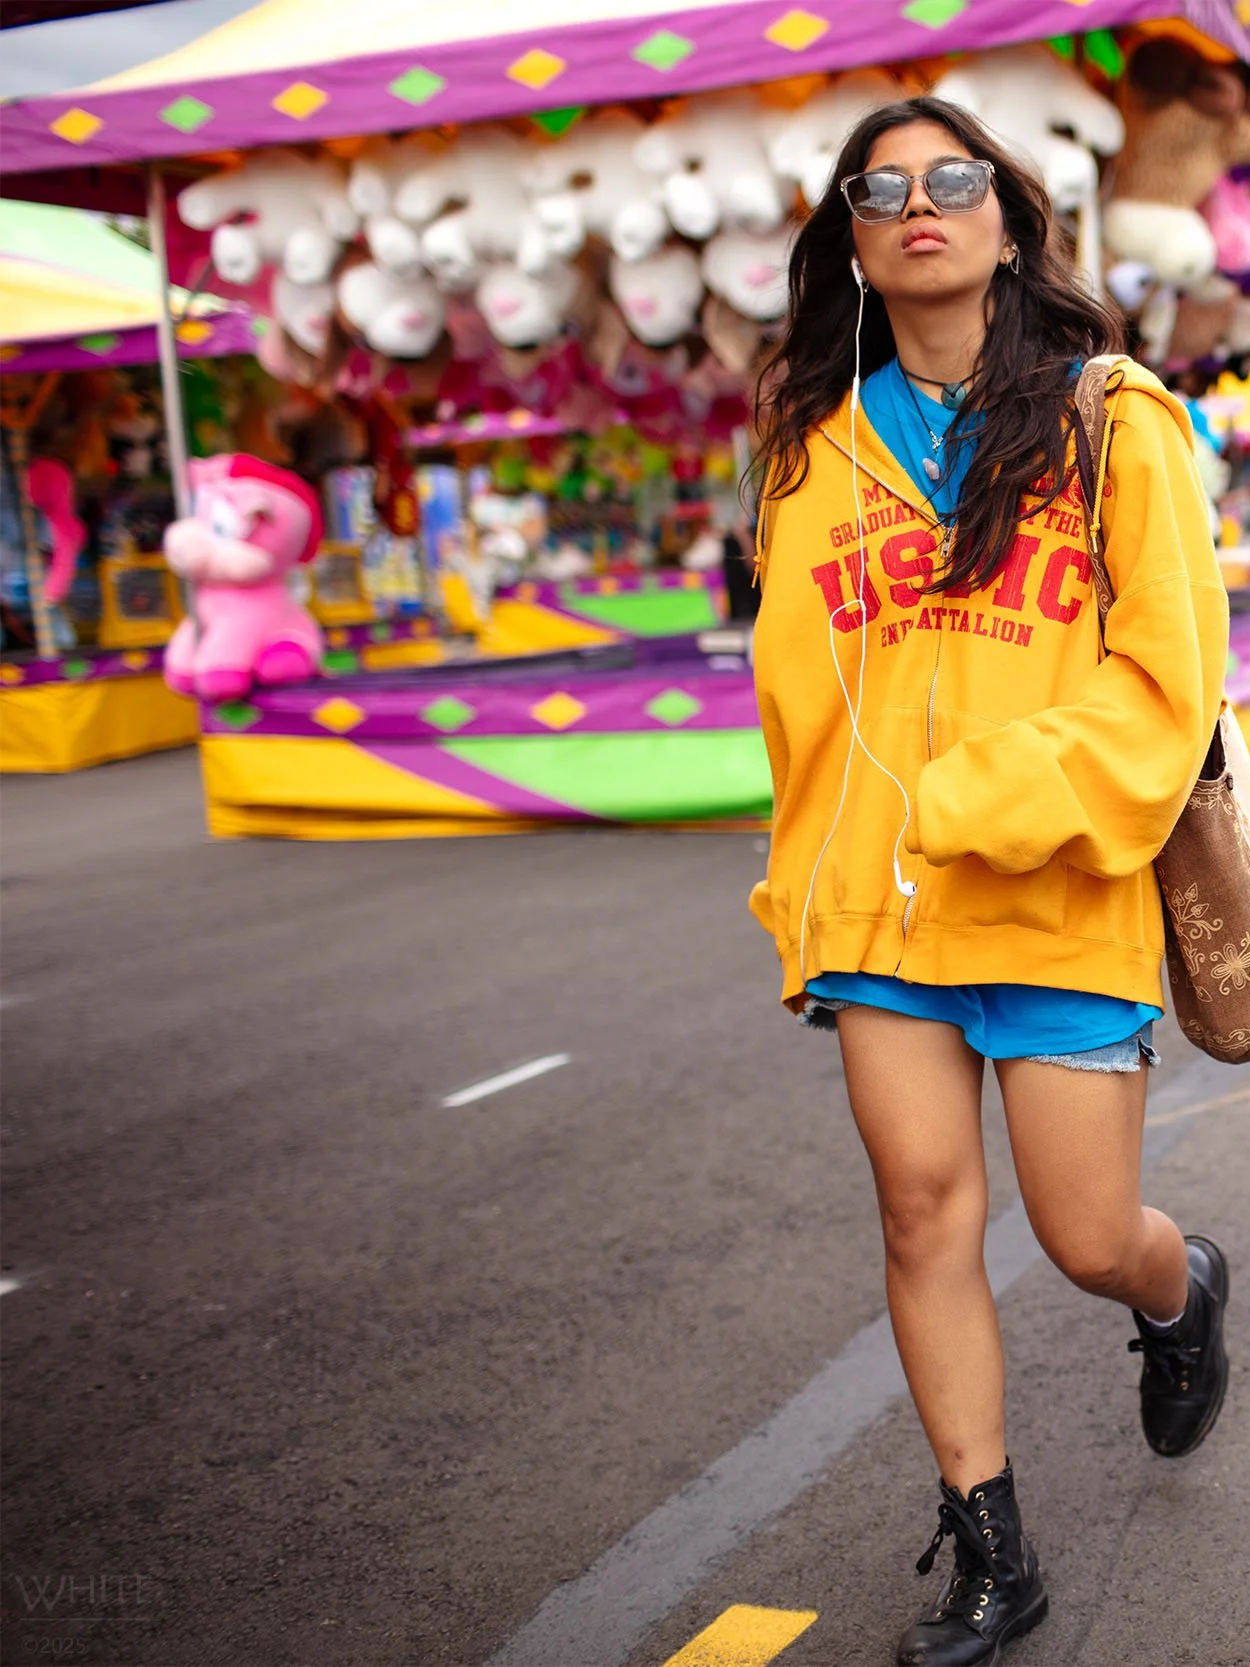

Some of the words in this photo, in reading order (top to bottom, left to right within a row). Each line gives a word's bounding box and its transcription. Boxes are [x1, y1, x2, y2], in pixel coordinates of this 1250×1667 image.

[829, 502, 917, 548] GRADUAT
[1044, 507, 1082, 539] THE
[916, 607, 1034, 647] ATTALION
